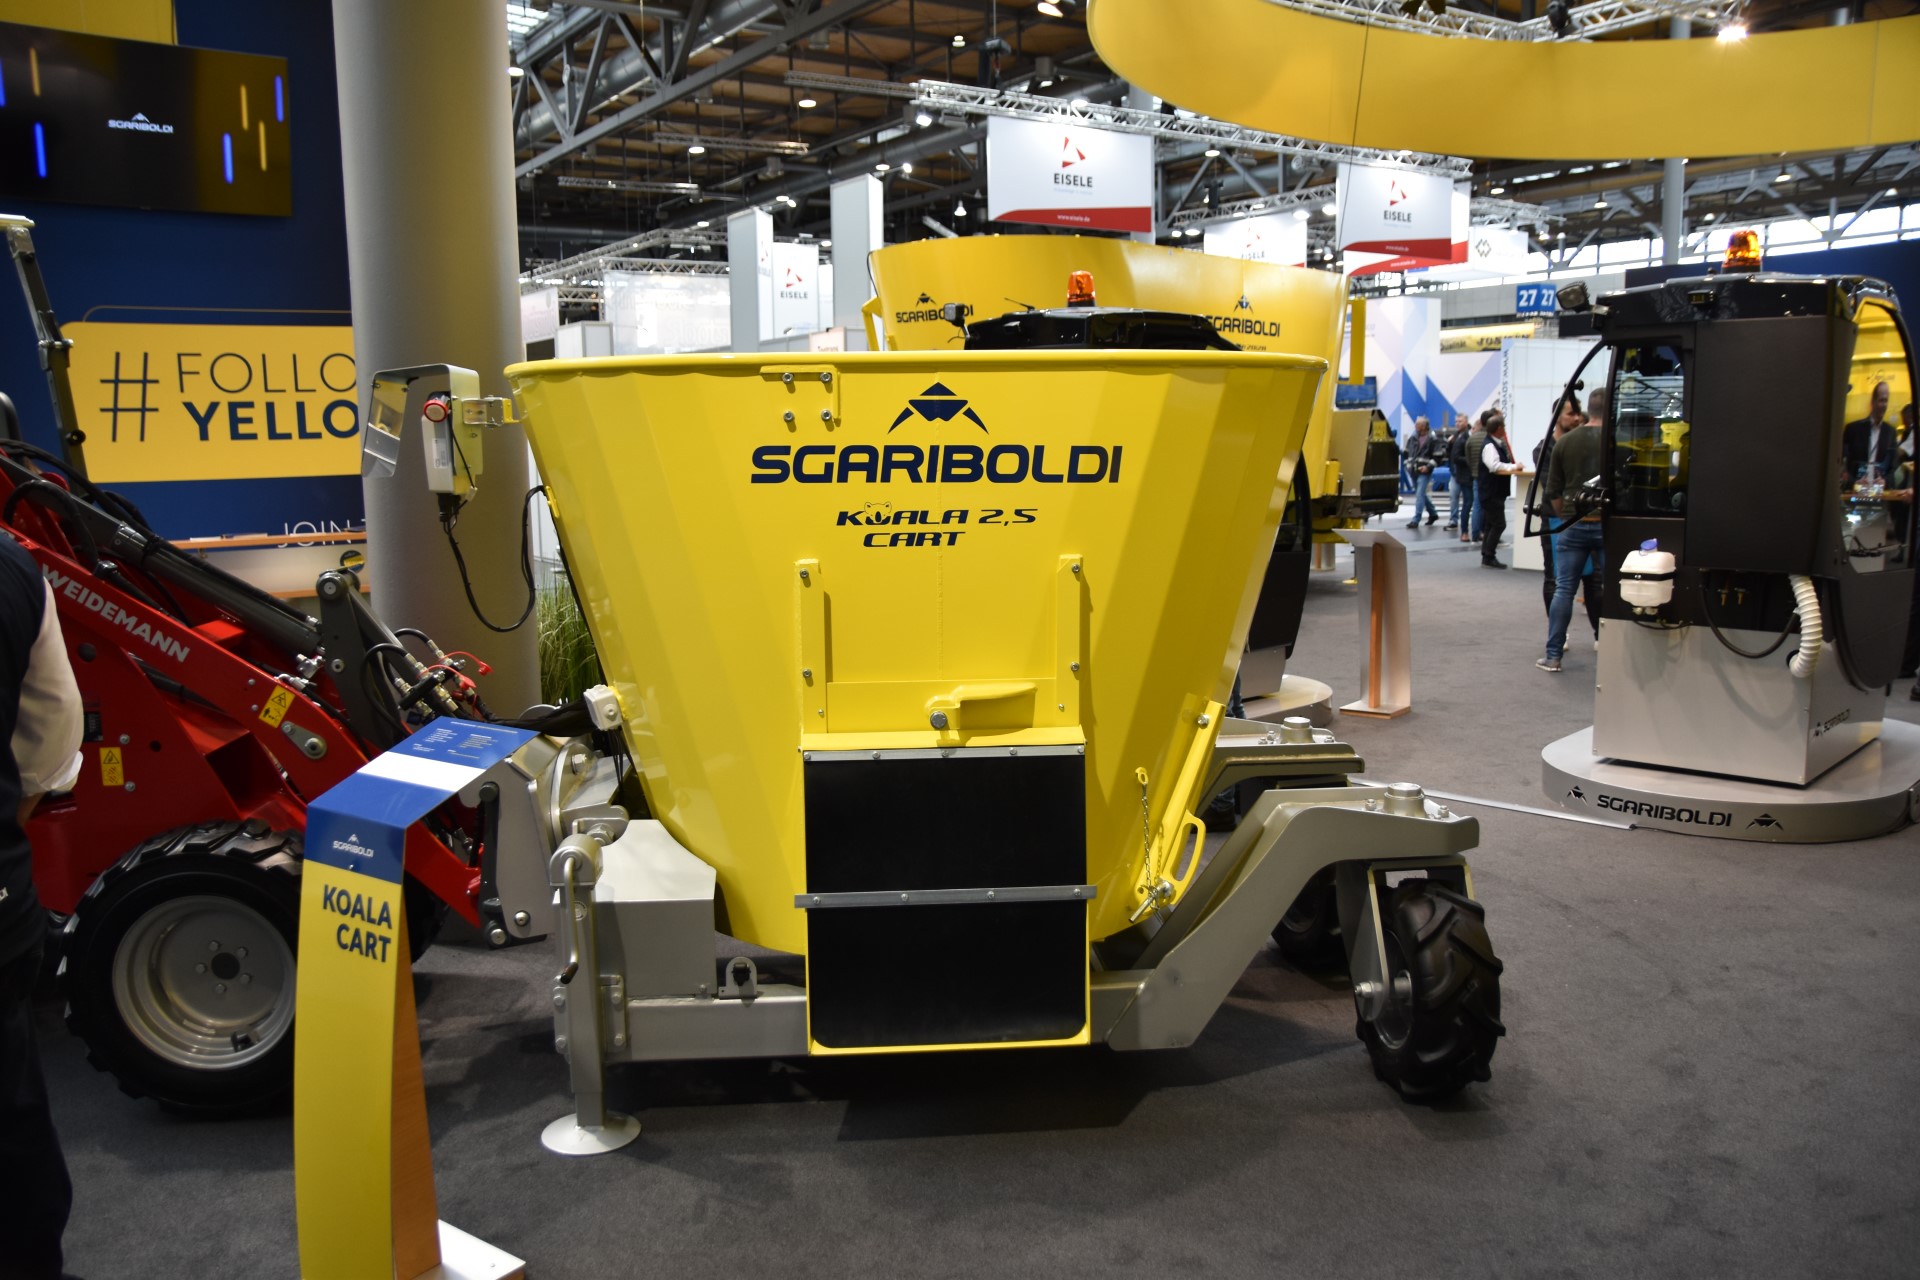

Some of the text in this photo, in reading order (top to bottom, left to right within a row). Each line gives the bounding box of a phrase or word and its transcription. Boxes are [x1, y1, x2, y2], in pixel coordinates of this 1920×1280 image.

[108, 119, 174, 133] SGARIBOLDI
[1053, 172, 1093, 187] EISELE
[1383, 209, 1412, 223] EISELE
[780, 291, 809, 299] EISELE
[1518, 288, 1538, 308] 27
[1541, 288, 1555, 308] 27
[750, 444, 1123, 484] SGARIBOLDI
[836, 501, 1038, 527] KOALA 2,5
[277, 519, 352, 548] JOIN
[862, 531, 966, 547] CART
[42, 563, 191, 663] WEIDEMANN
[1597, 794, 1732, 827] SGARIBOLDI
[332, 840, 374, 858] SGARIBOLDI
[323, 884, 393, 929] KOALA
[336, 923, 391, 963] CART
